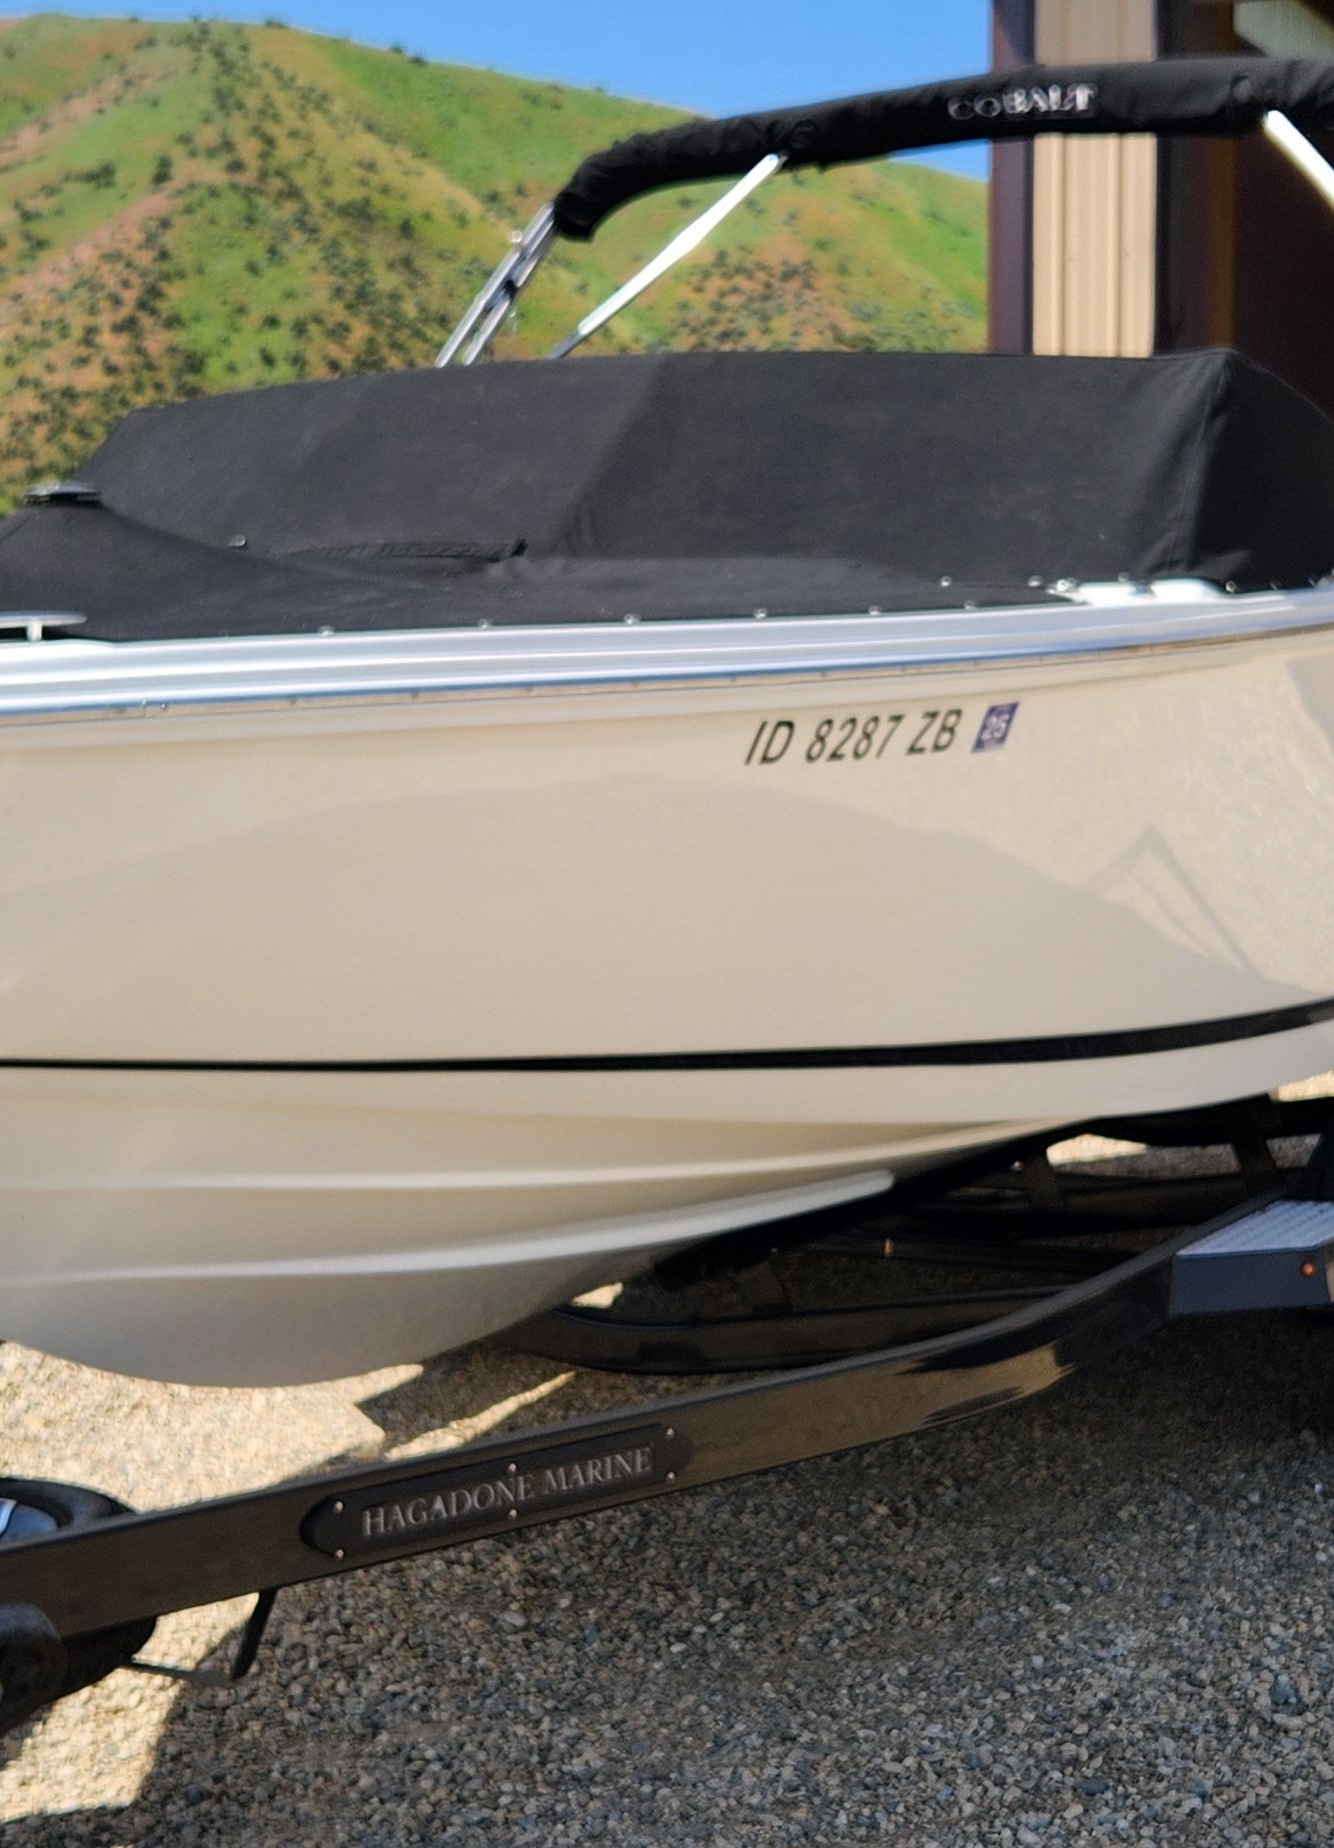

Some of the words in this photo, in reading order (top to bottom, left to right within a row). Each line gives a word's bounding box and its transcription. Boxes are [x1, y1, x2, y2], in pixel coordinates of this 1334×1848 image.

[947, 83, 1098, 120] COBALT
[744, 719, 795, 765] ID
[805, 713, 904, 763] 8287
[906, 708, 962, 756] ZB
[362, 1473, 536, 1537] HAGADONE
[542, 1446, 654, 1495] MARINE
